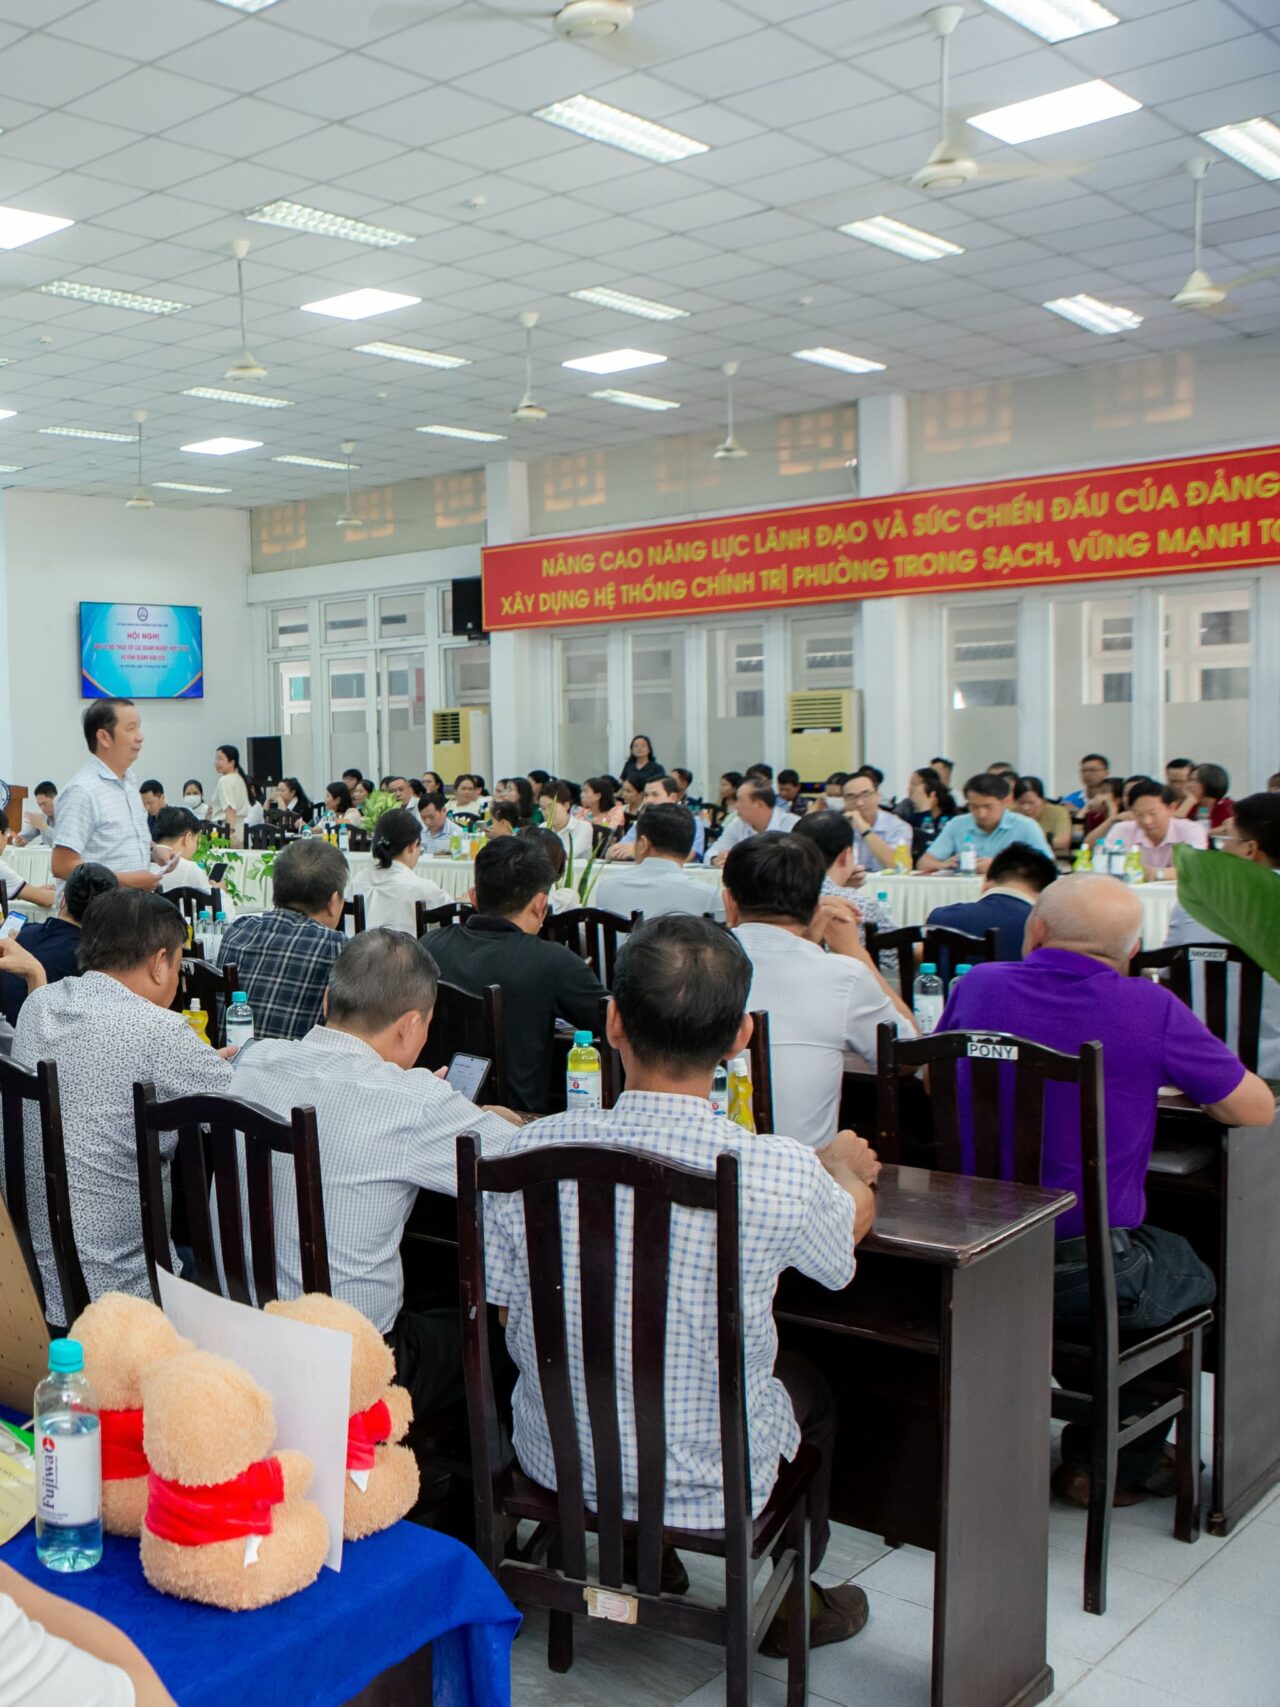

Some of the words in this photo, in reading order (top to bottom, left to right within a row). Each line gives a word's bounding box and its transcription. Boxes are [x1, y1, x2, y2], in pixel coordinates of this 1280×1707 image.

[542, 552, 596, 578] NÂNG
[600, 548, 643, 572] CAO
[647, 540, 706, 568] NĂNG
[712, 535, 750, 564] LỰC
[754, 526, 810, 555] LÃNH
[815, 520, 867, 550] ĐẠO
[874, 508, 906, 540] VÀ
[912, 503, 961, 538] SỨC
[966, 493, 1044, 532] CHIẾN
[1051, 484, 1108, 522] ĐẤU
[1116, 477, 1180, 514] CỦA
[1185, 468, 1280, 506] ĐẢNG
[500, 591, 535, 616] XÂY
[538, 587, 590, 616] DỤNG
[594, 581, 616, 610] HỆ
[620, 574, 688, 606] THỐNG
[692, 566, 756, 600] CHÍNH
[758, 564, 790, 595] TRỊ
[793, 555, 889, 590] PHƯỜNG
[893, 549, 978, 580] TRONG
[982, 541, 1062, 574] SẠCH,
[1068, 530, 1152, 564] VỮNG
[1157, 520, 1250, 558] MẠNH
[969, 1043, 1013, 1058] PONY
[42, 1454, 60, 1509] Fujiwa
